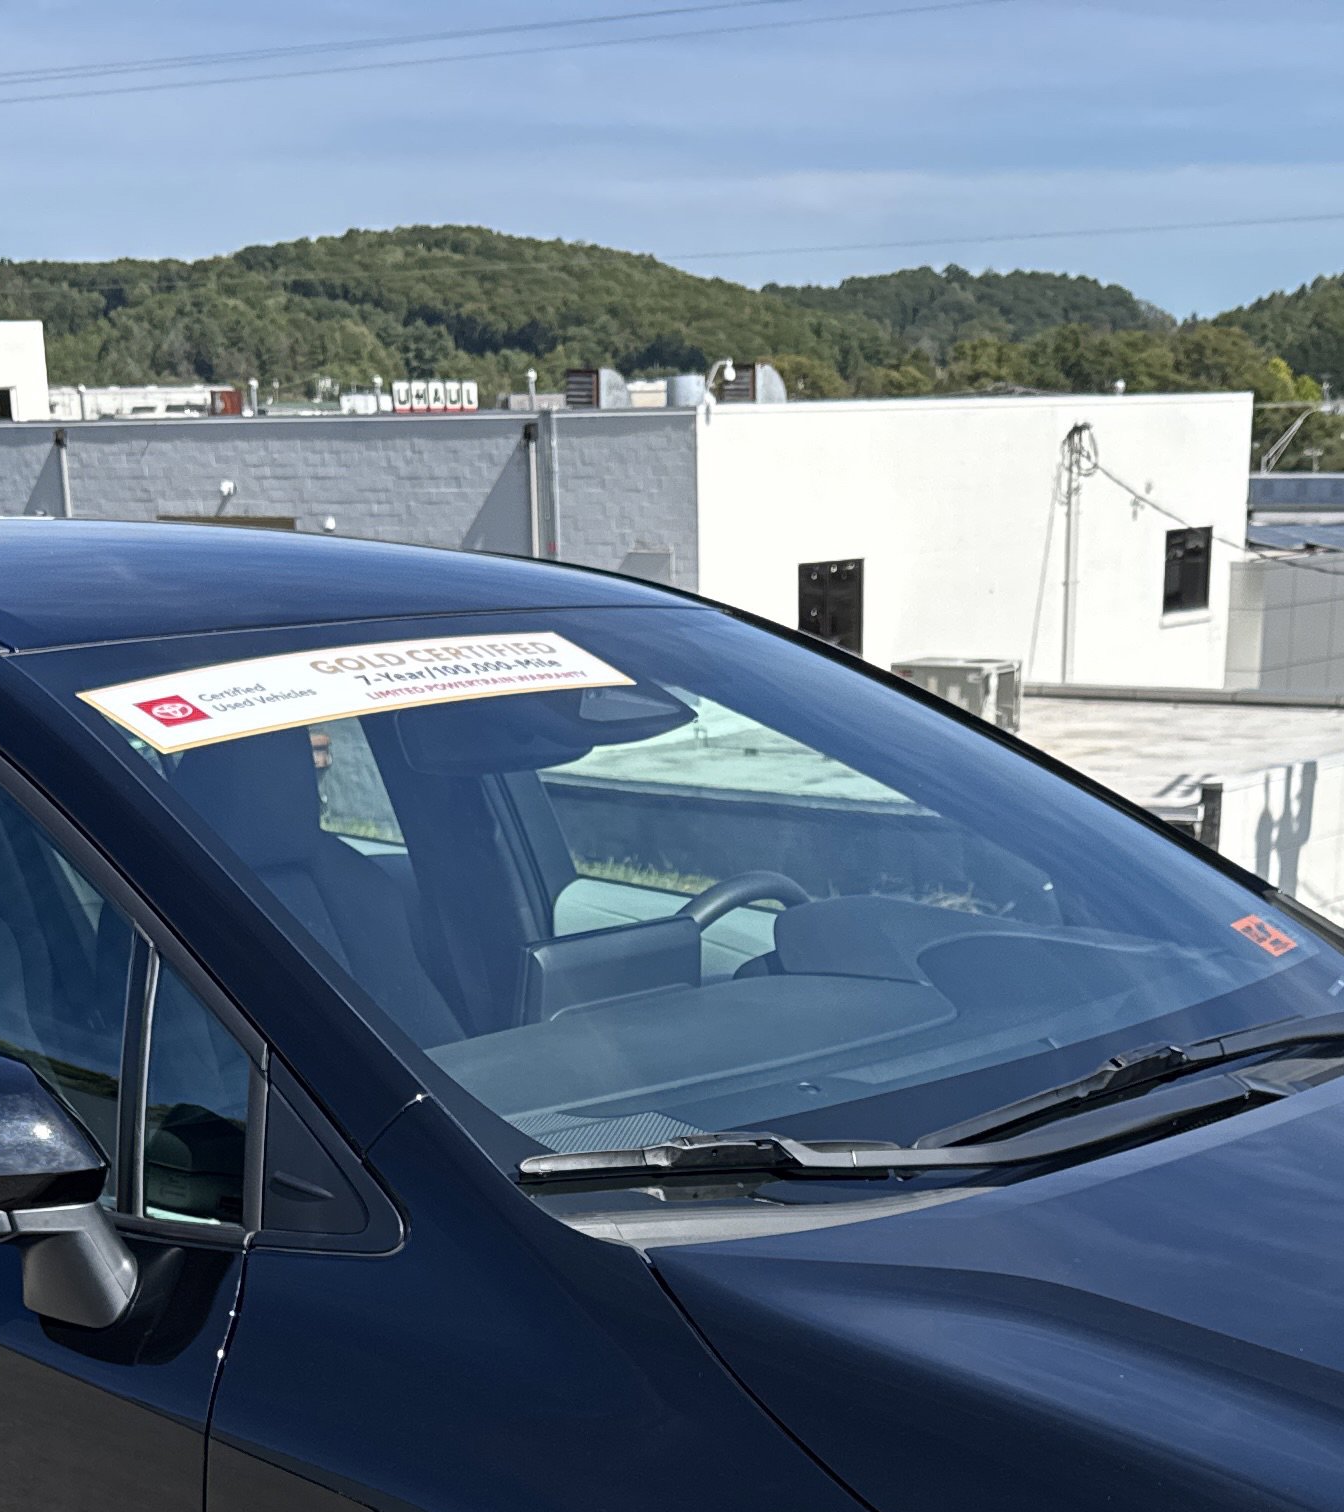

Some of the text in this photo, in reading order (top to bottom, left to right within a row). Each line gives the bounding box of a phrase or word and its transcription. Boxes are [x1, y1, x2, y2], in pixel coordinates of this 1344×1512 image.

[309, 642, 557, 675] GOLD CERTIFIED
[198, 683, 267, 701] Certified
[365, 670, 588, 700] LIMITED POWERTRAIN WARRANTY
[212, 689, 317, 712] Used Vehicles
